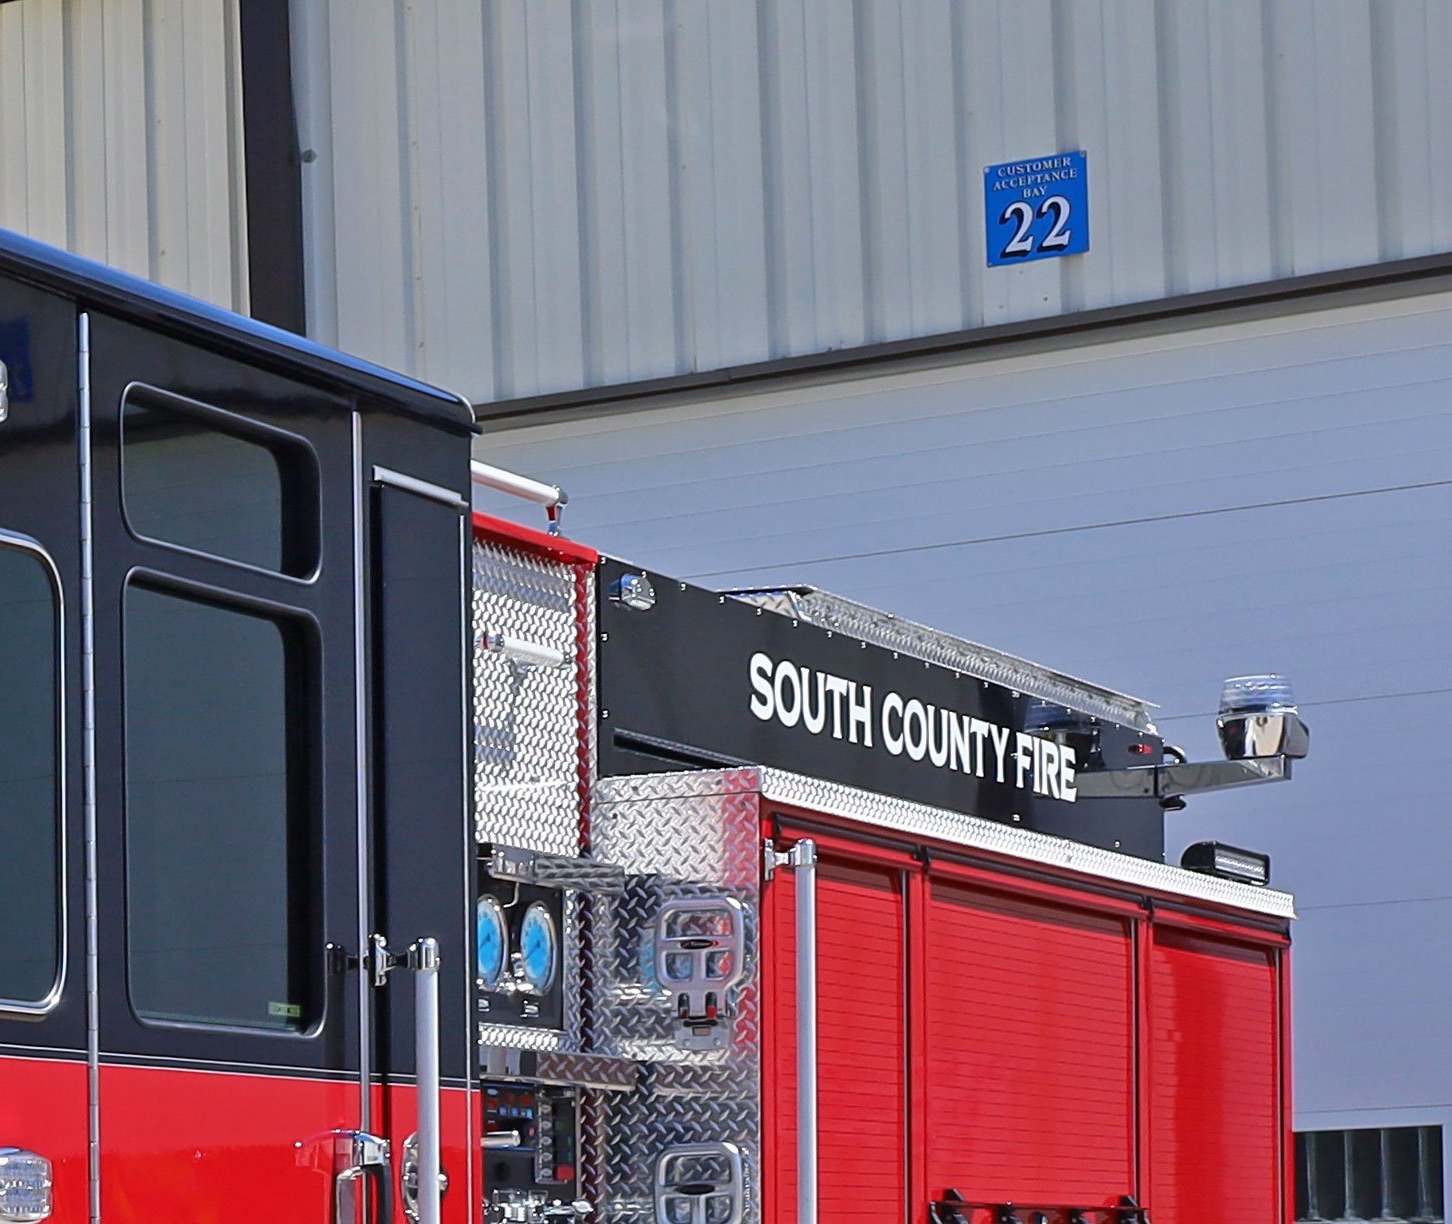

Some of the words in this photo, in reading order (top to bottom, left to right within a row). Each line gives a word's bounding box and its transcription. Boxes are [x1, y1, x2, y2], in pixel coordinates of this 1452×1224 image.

[998, 156, 1071, 177] CUSTOMER
[993, 168, 1077, 191] ACCEPTANCE
[1022, 186, 1047, 198] BAY
[1000, 195, 1072, 258] 22
[749, 652, 872, 747] SOUTH
[881, 692, 1009, 785] COUNTY
[1014, 731, 1077, 803] FIRE
